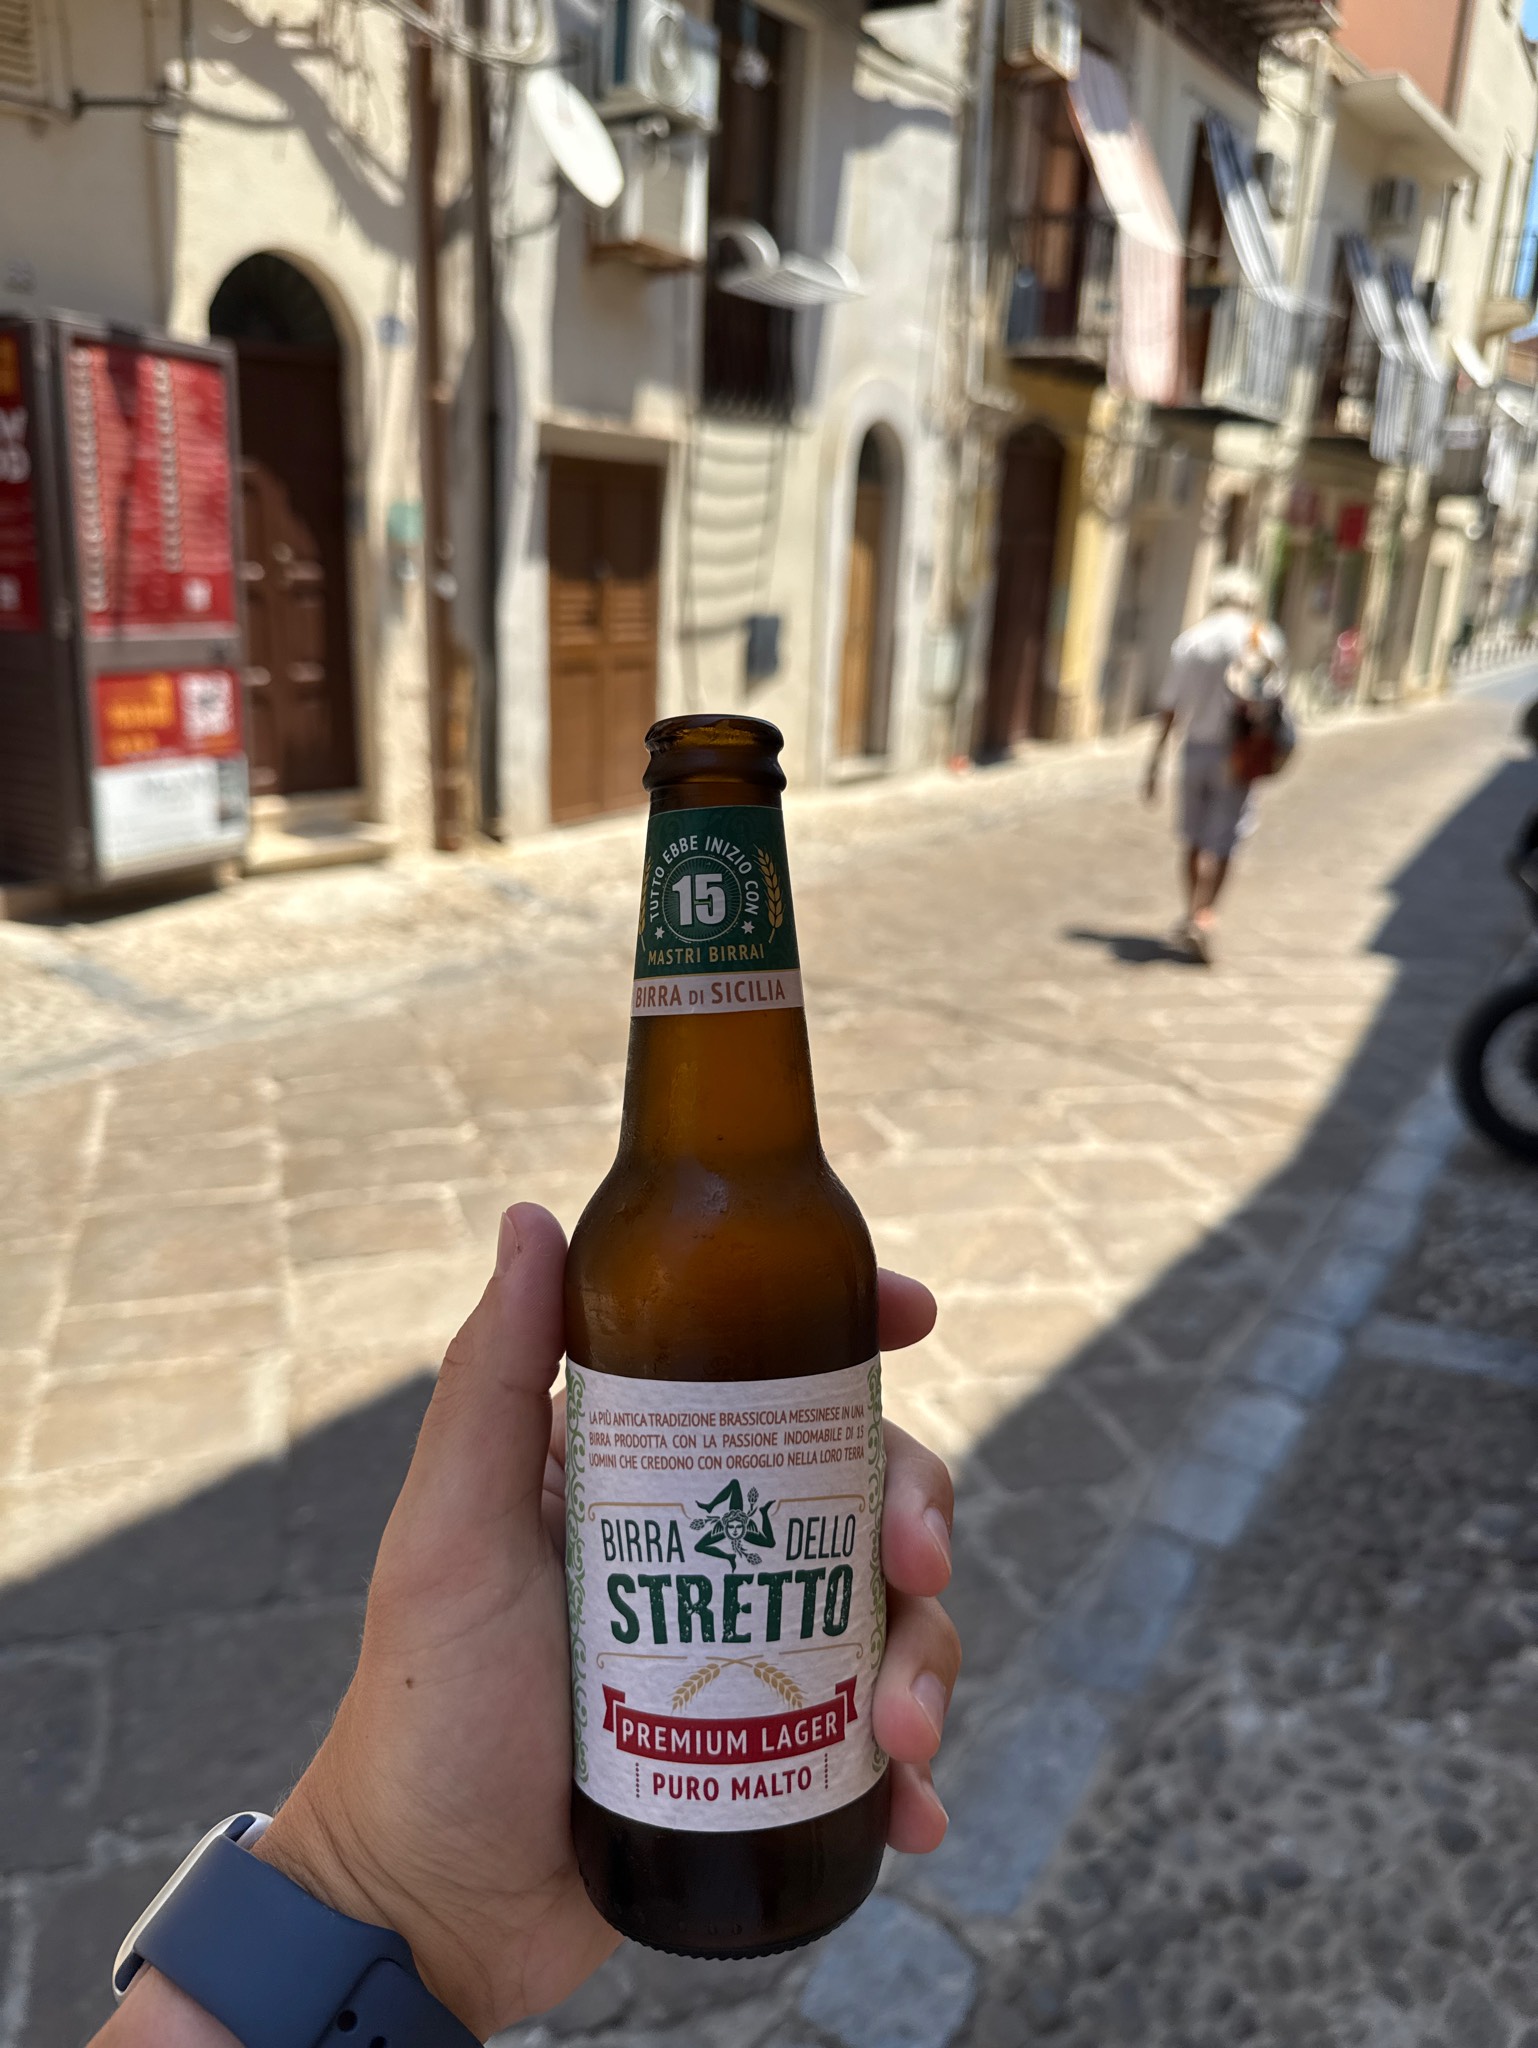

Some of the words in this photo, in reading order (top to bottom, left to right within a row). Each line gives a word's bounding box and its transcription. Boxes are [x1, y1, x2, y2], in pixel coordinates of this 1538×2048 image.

[650, 866, 665, 923] TUTTO
[662, 835, 699, 865] EBBE
[705, 836, 752, 875] INIZIO
[744, 880, 760, 916] CON
[672, 873, 726, 926] 15
[648, 948, 701, 966] MASTRI
[709, 943, 765, 963] BIRRAI
[635, 984, 682, 1008] BIRRA
[689, 990, 704, 1005] DI
[711, 979, 786, 1004] SICILIA
[589, 1411, 598, 1425] LA
[598, 1409, 611, 1425] PIÙ
[613, 1413, 647, 1426] ANTICA
[648, 1413, 716, 1427] TRADIZIONE
[719, 1410, 787, 1426] BRASSICOLA
[789, 1407, 840, 1423] MESSINESE
[841, 1405, 850, 1419] IN
[851, 1404, 865, 1418] UNA
[589, 1432, 611, 1447] BIRRA
[614, 1434, 667, 1448] PRODOTTA
[672, 1435, 697, 1448] CON
[703, 1434, 717, 1448] LA
[722, 1432, 778, 1448] PASSIONE
[784, 1427, 842, 1445] INDOMABILE
[845, 1426, 854, 1440] DI
[856, 1425, 864, 1439] 15
[589, 1453, 616, 1468] UOMINI
[619, 1454, 638, 1469] CHE
[641, 1455, 694, 1470] CREDONO
[698, 1456, 722, 1469] CON
[726, 1453, 784, 1469] ORGOGLIO
[787, 1451, 818, 1466] NELLA
[820, 1448, 843, 1463] LORO
[844, 1446, 865, 1461] TERRA
[601, 1518, 685, 1563] BIRRA
[786, 1513, 856, 1561] DELLO
[607, 1564, 853, 1644] STRETTO
[621, 1718, 747, 1756] PREMIUM
[762, 1711, 838, 1752] LAGER
[653, 1772, 720, 1800] PURO
[732, 1766, 812, 1800] MALTO
